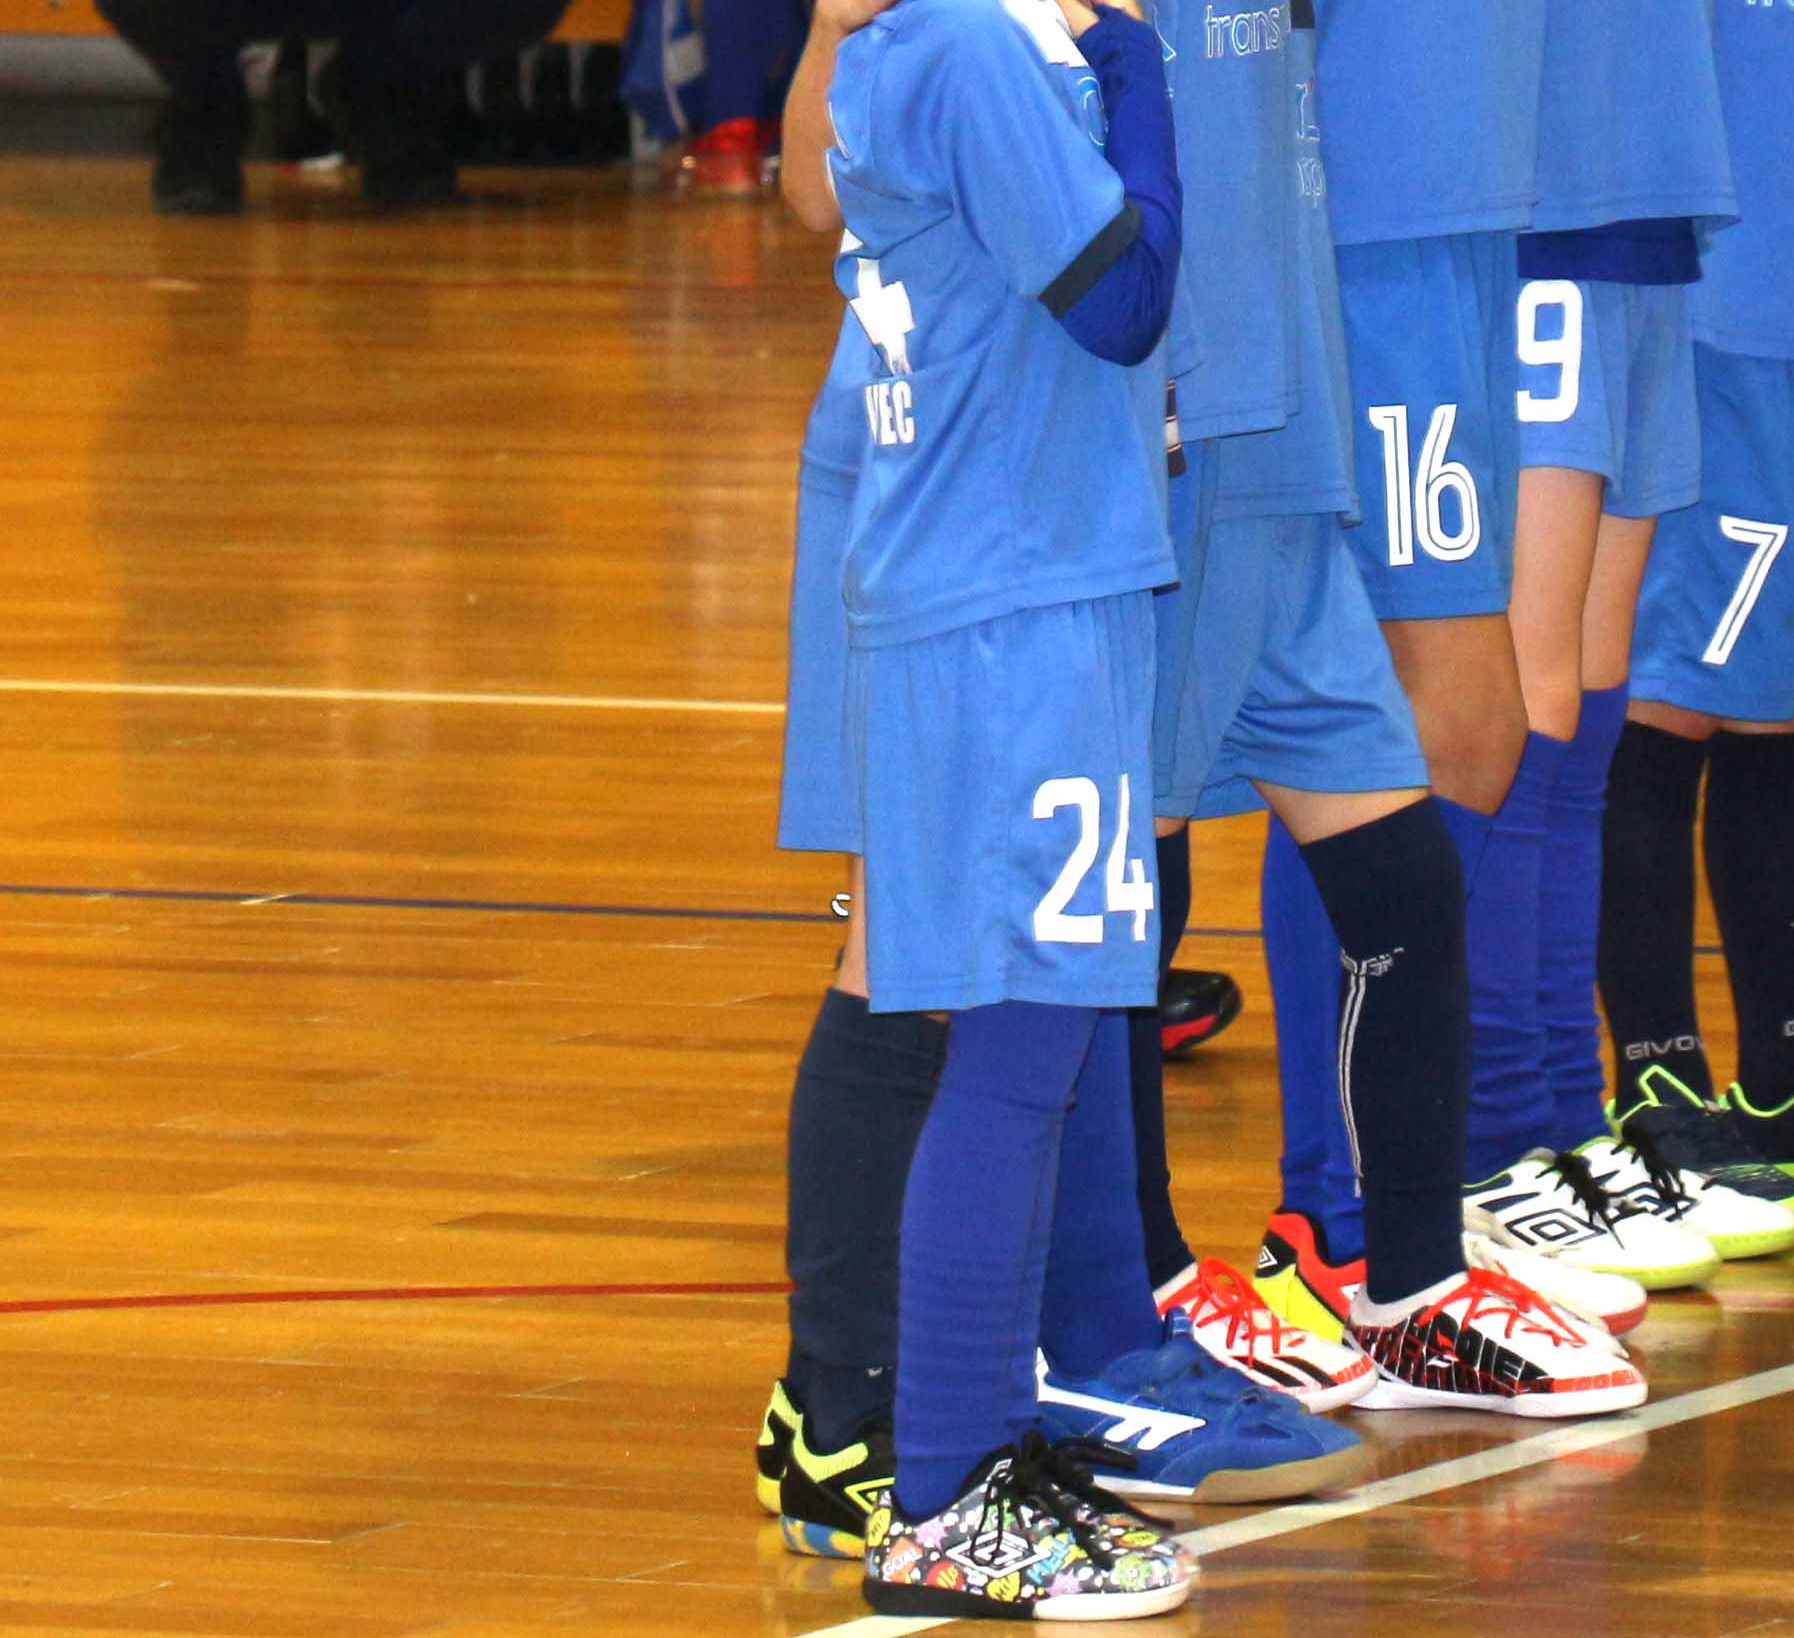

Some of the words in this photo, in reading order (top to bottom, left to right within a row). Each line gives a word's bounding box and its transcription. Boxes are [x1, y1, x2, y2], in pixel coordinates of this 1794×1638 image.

[1206, 4, 1285, 59] trans
[1517, 279, 1583, 422] 9
[1368, 404, 1480, 567] 16
[1701, 515, 1789, 666] 7
[1032, 773, 1154, 943] 24
